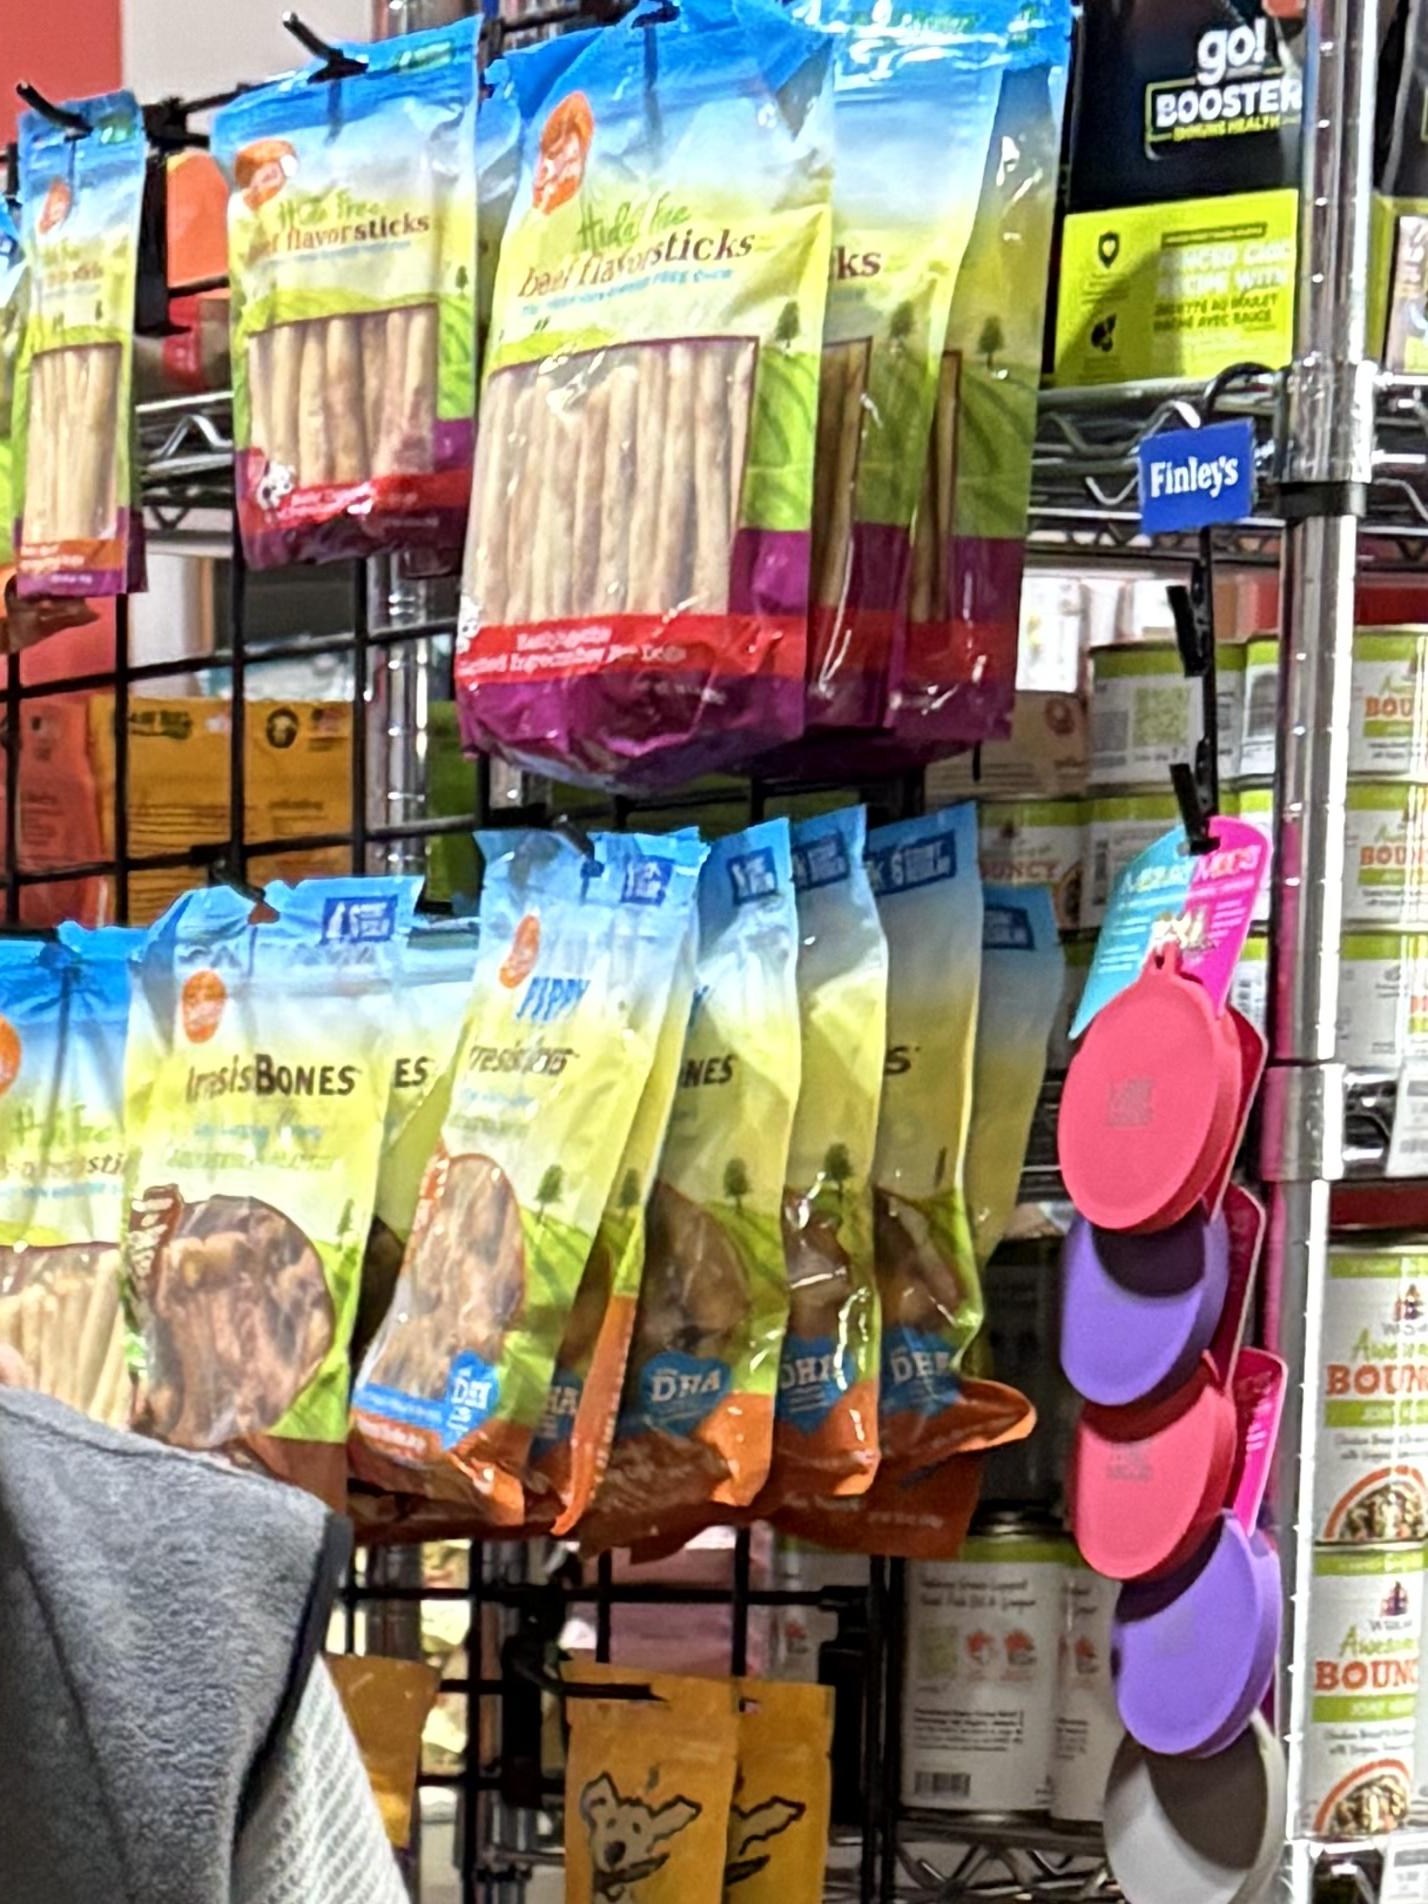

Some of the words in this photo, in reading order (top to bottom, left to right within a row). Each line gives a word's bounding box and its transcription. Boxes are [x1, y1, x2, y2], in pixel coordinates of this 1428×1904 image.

[1197, 17, 1267, 86] go!
[1156, 78, 1303, 127] BOOSTER
[1149, 455, 1239, 499] Finley's
